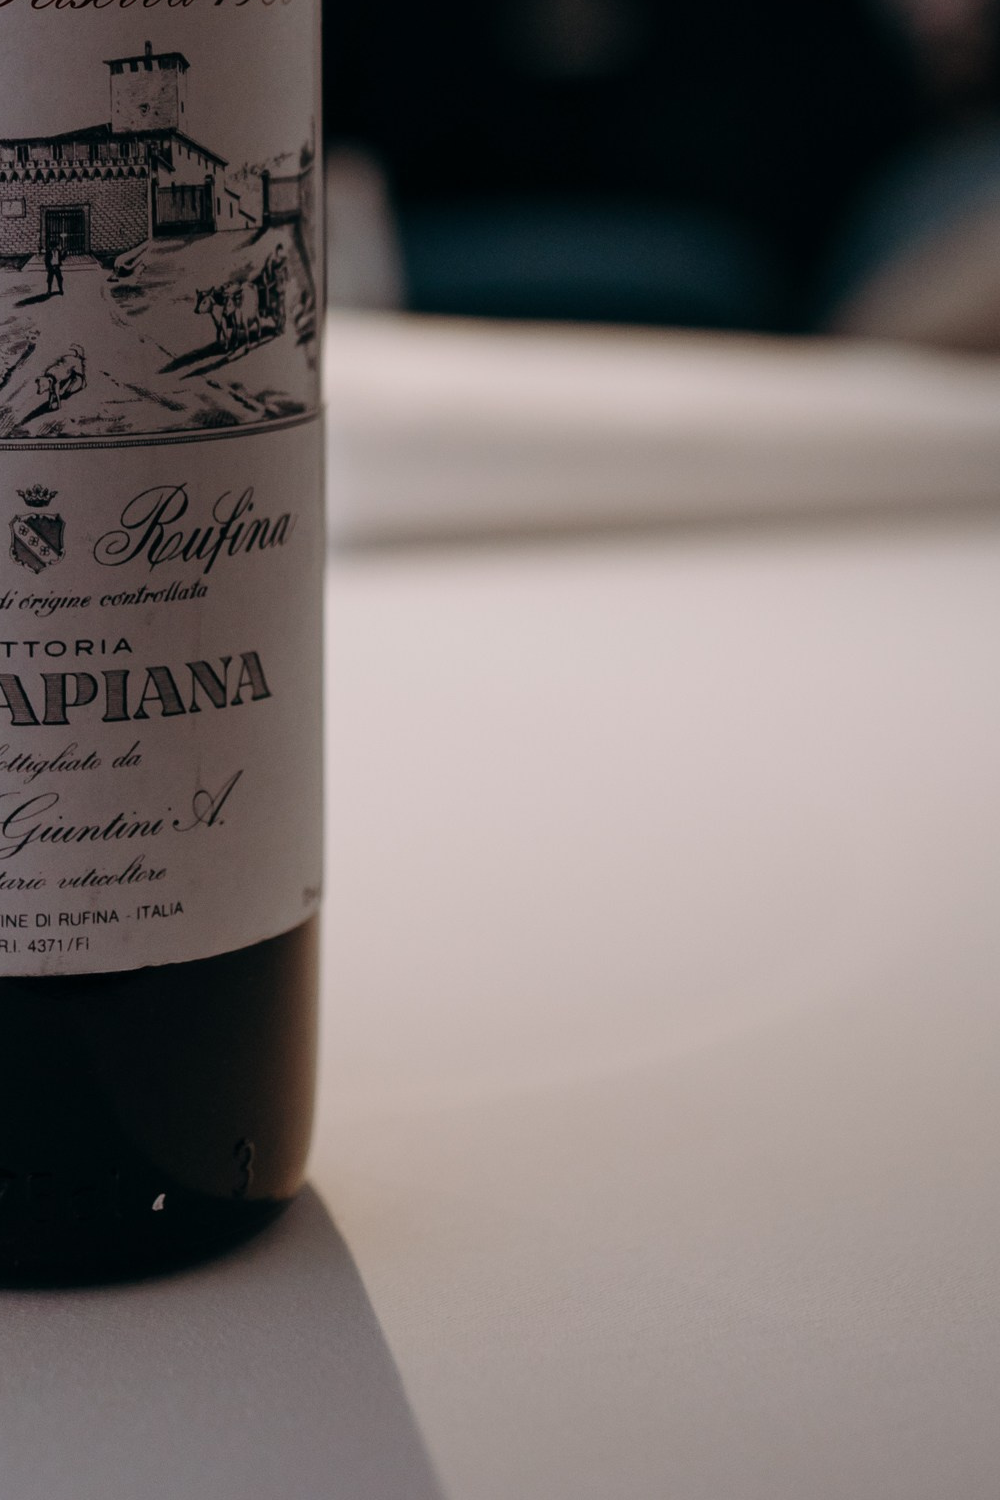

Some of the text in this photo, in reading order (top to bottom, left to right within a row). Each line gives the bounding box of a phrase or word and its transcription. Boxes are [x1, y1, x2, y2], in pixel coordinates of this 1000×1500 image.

[92, 482, 300, 575] Rufina
[17, 588, 92, 618] origine
[98, 579, 209, 608] controllata
[111, 740, 143, 769] da
[58, 853, 168, 891] viticoltore
[35, 913, 52, 928] DI
[58, 909, 120, 927] RUFINA
[136, 901, 184, 921] ITALIA
